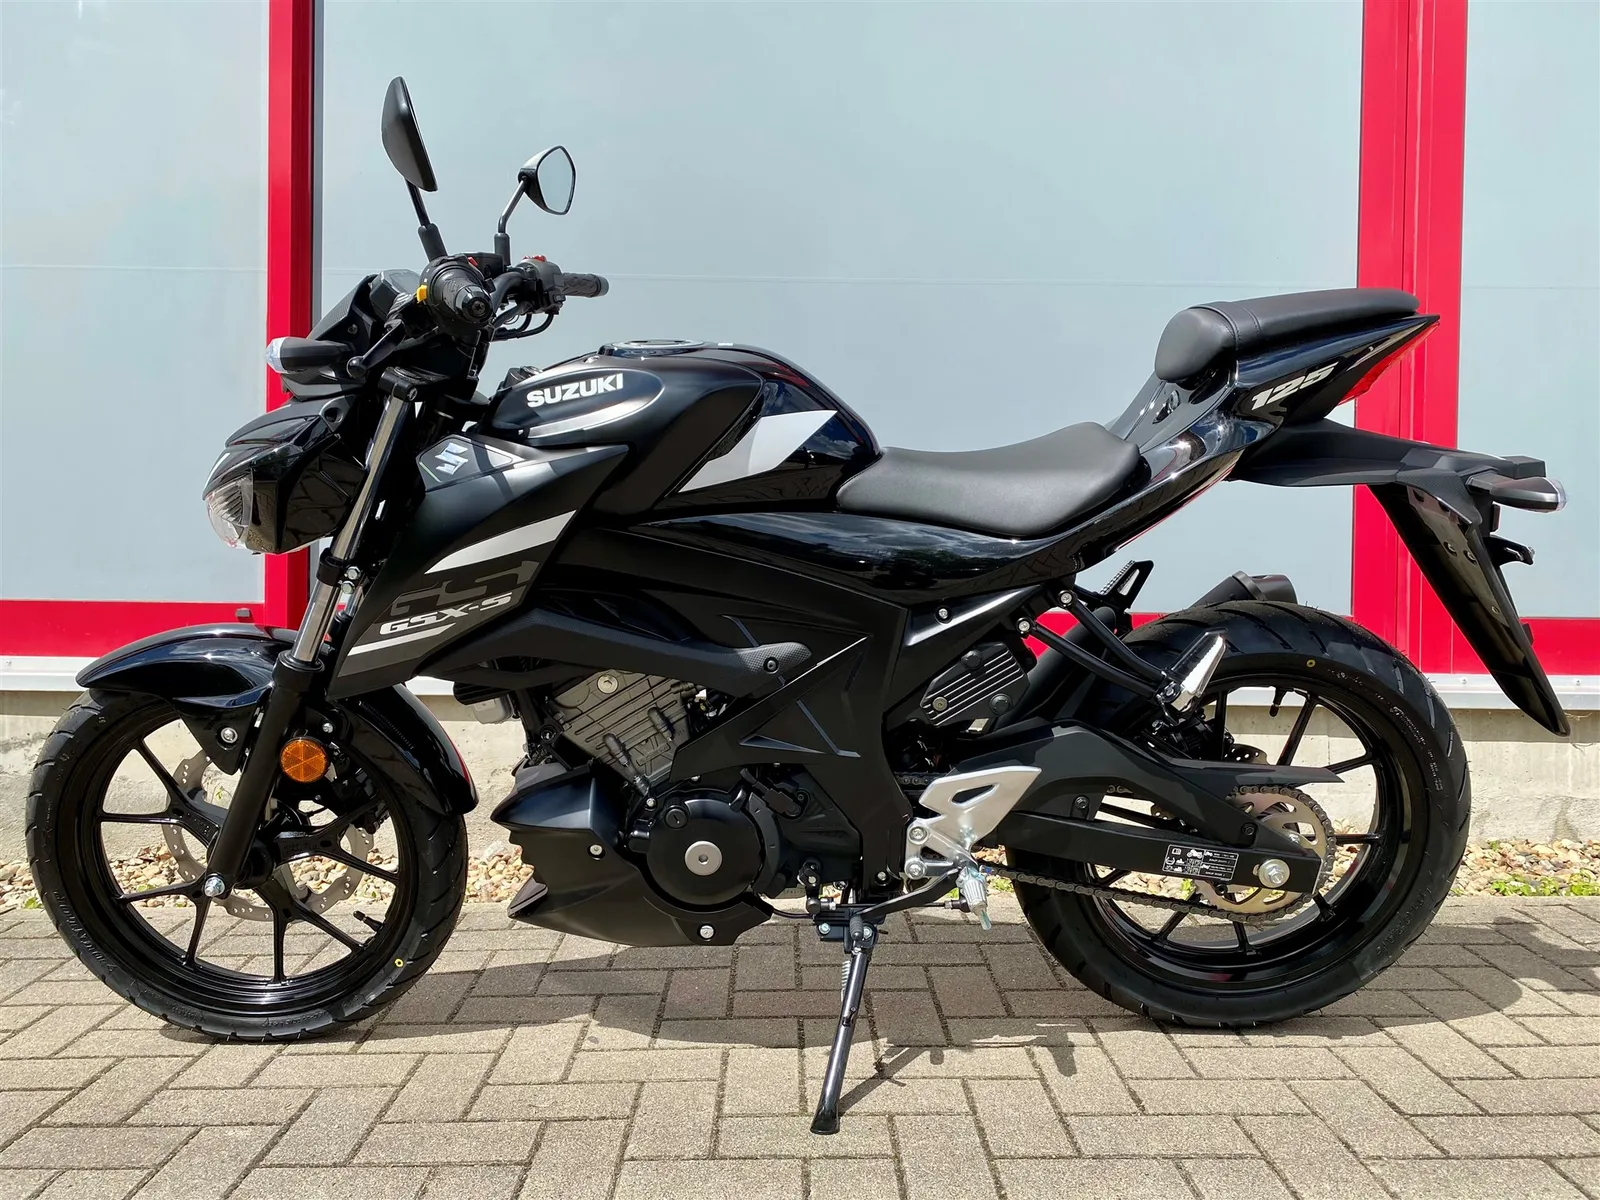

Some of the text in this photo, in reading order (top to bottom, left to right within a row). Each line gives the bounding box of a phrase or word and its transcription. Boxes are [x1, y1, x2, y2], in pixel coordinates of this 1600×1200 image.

[526, 373, 624, 408] SUZUKI
[1251, 361, 1339, 410] 125
[379, 592, 513, 635] GSX-S
